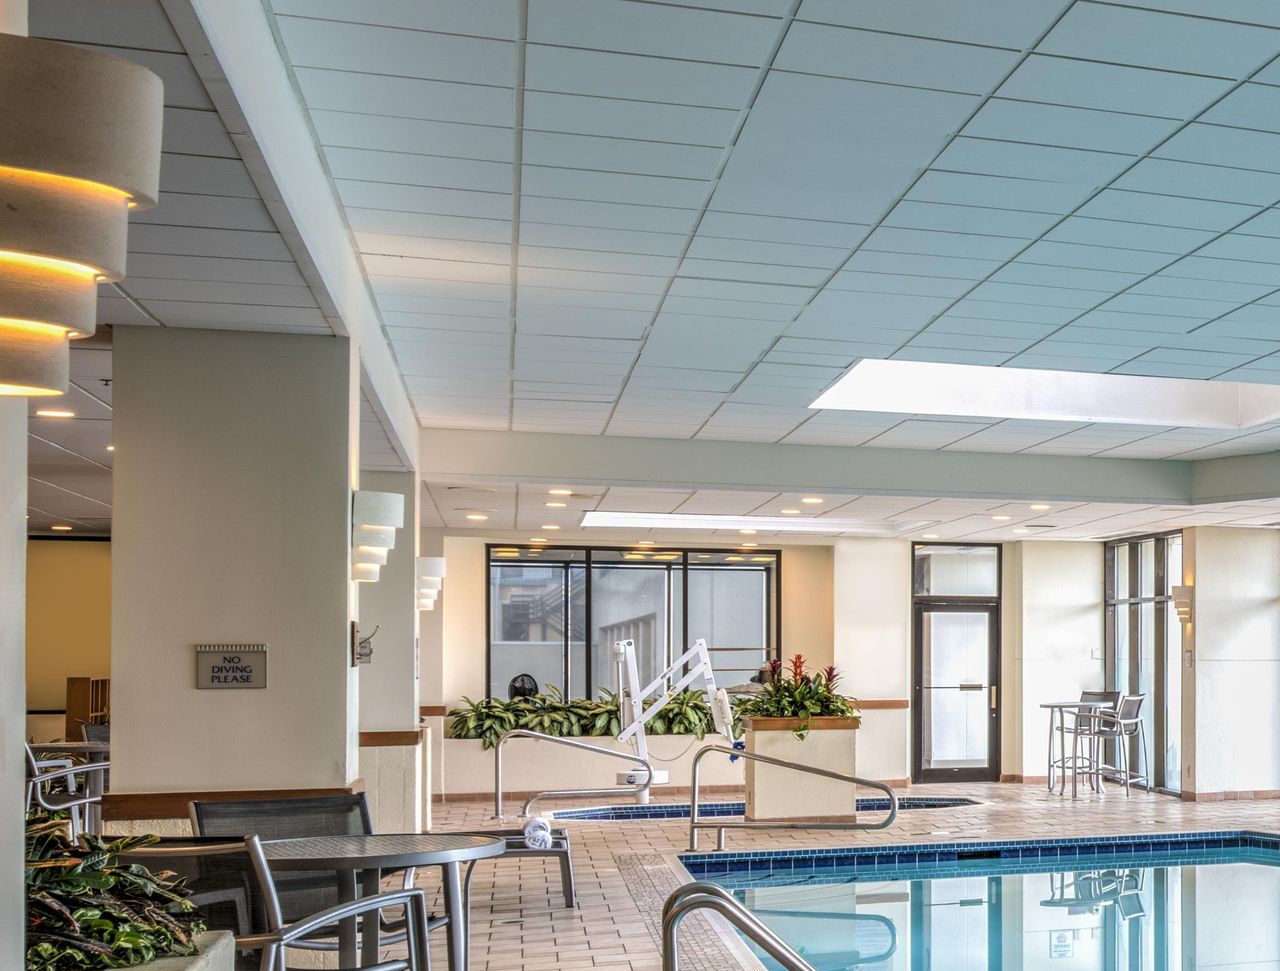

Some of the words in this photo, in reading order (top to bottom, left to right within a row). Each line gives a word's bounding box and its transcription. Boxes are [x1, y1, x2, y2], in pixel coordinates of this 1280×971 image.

[223, 656, 241, 664] NO
[211, 666, 253, 674] DIVING
[211, 675, 253, 683] PLEASE
